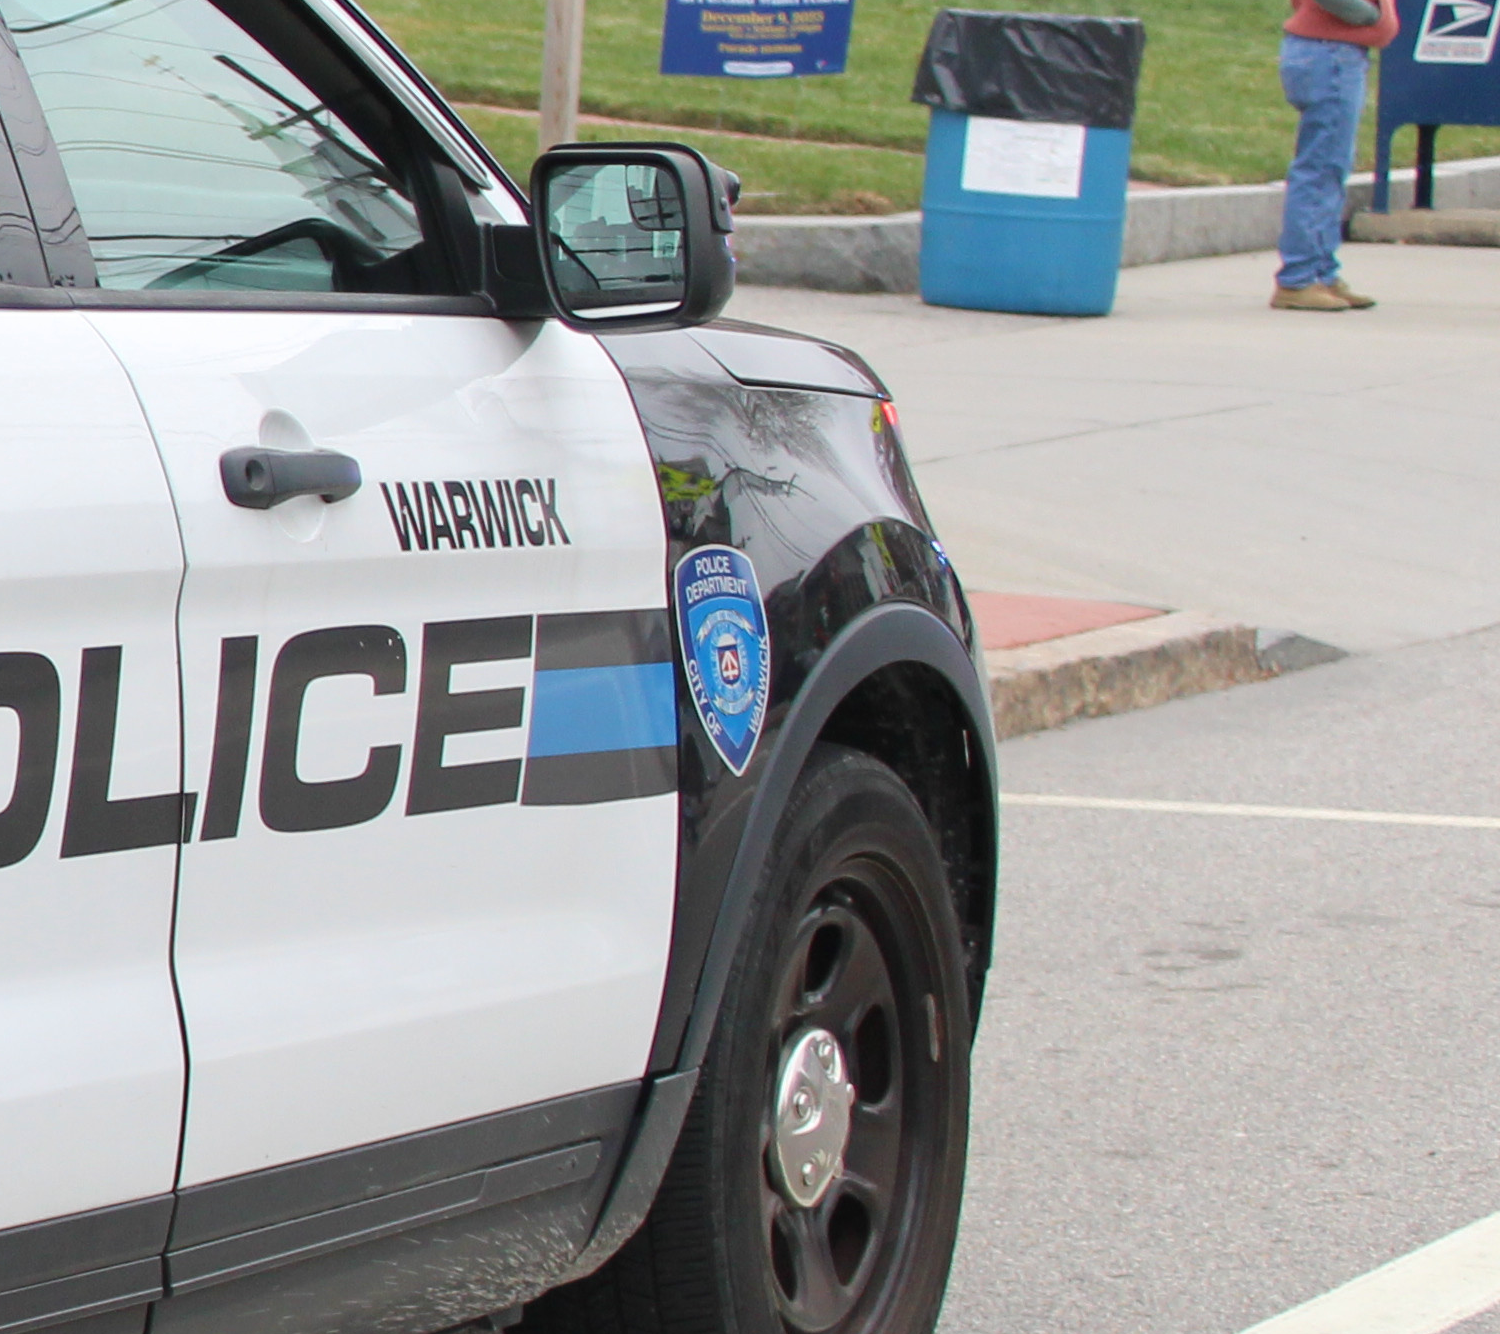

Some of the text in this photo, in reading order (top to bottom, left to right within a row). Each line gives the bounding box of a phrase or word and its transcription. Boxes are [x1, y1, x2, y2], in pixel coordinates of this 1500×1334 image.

[379, 477, 571, 553] WARWICK
[686, 576, 747, 605] DEPARTMENT
[695, 555, 731, 576] POLICE
[688, 659, 708, 705] CITY
[706, 711, 723, 737] OF
[748, 634, 768, 734] WARWICK
